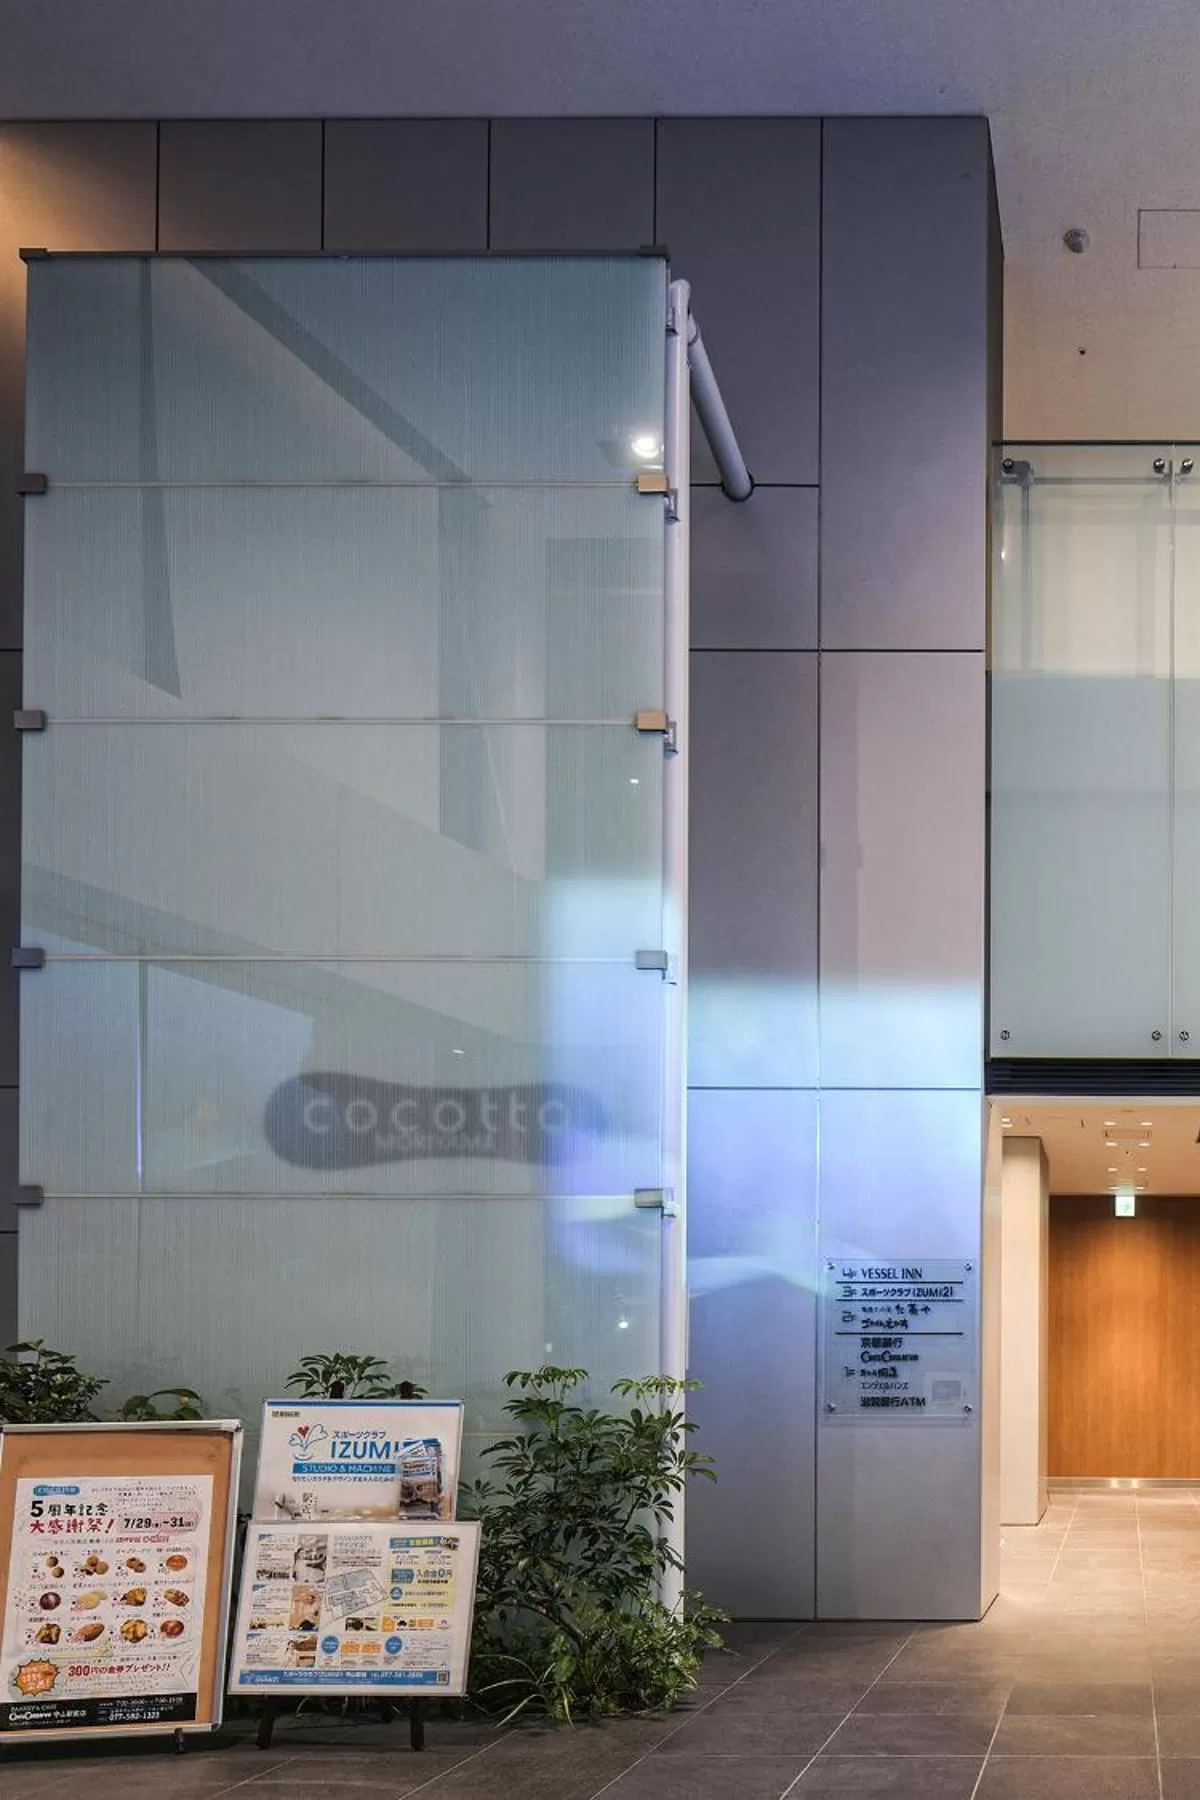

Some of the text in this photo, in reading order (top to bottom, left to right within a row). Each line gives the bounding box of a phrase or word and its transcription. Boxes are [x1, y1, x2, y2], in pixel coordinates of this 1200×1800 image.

[303, 1092, 571, 1134] cocotto
[861, 1268, 898, 1280] VESSEL
[901, 1268, 923, 1279] INN
[332, 1430, 387, 1440] スポーツクラブ
[301, 1463, 393, 1474] STUDIO & MACHINE
[29, 1499, 109, 1518] 5周年記念
